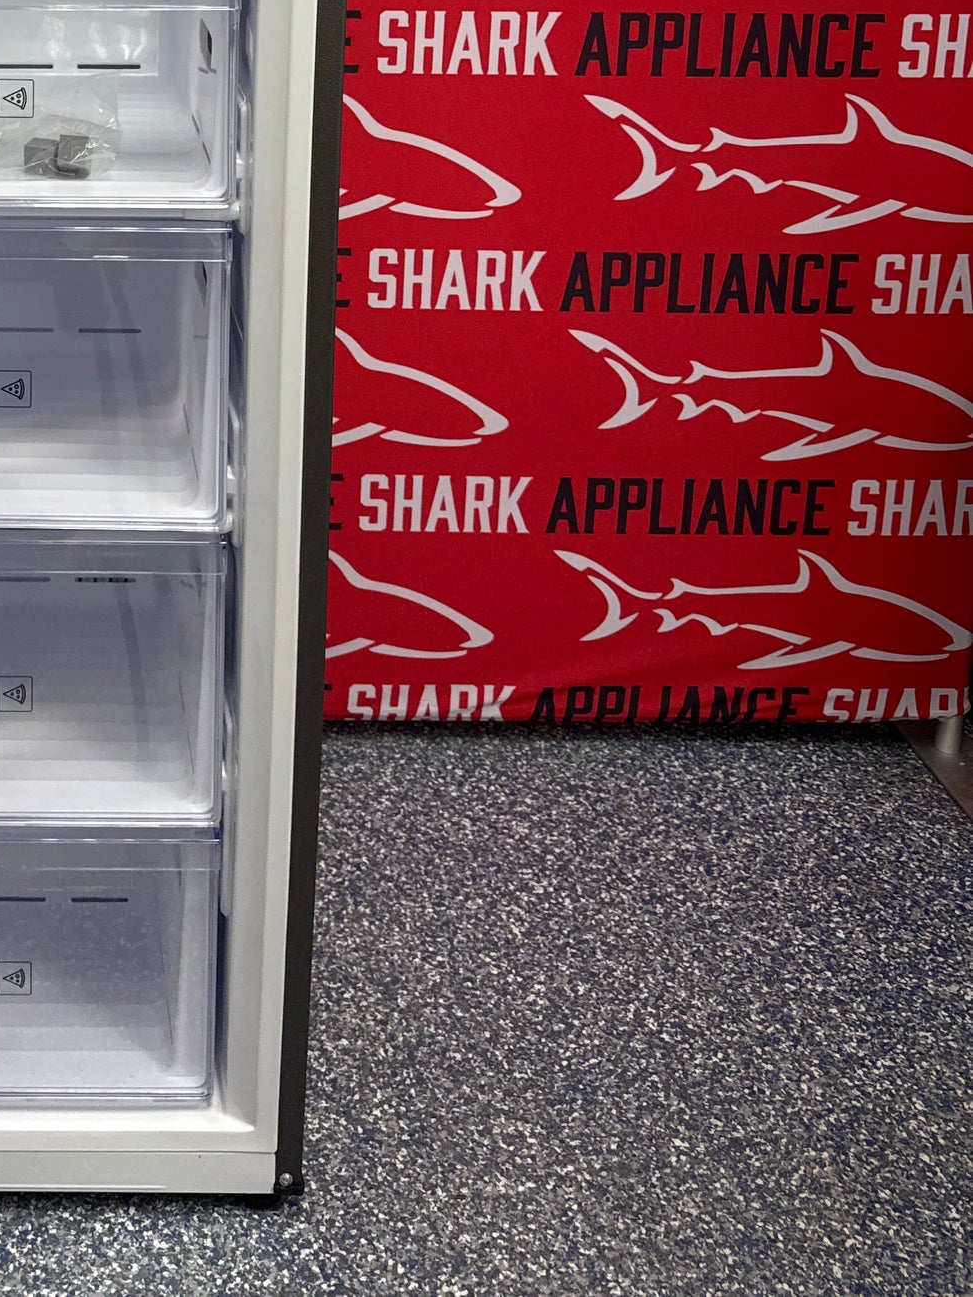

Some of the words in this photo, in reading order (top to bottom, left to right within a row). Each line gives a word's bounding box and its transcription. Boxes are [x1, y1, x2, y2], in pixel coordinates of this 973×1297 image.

[377, 9, 563, 75] SHARK
[574, 11, 886, 78] APPLIANCE
[898, 13, 973, 78] SH
[367, 248, 547, 311] SHARK
[559, 252, 860, 315] APPLIANCE
[358, 473, 533, 534] SHARK
[544, 477, 836, 536] APPLIANCE
[343, 683, 517, 722] SHARK
